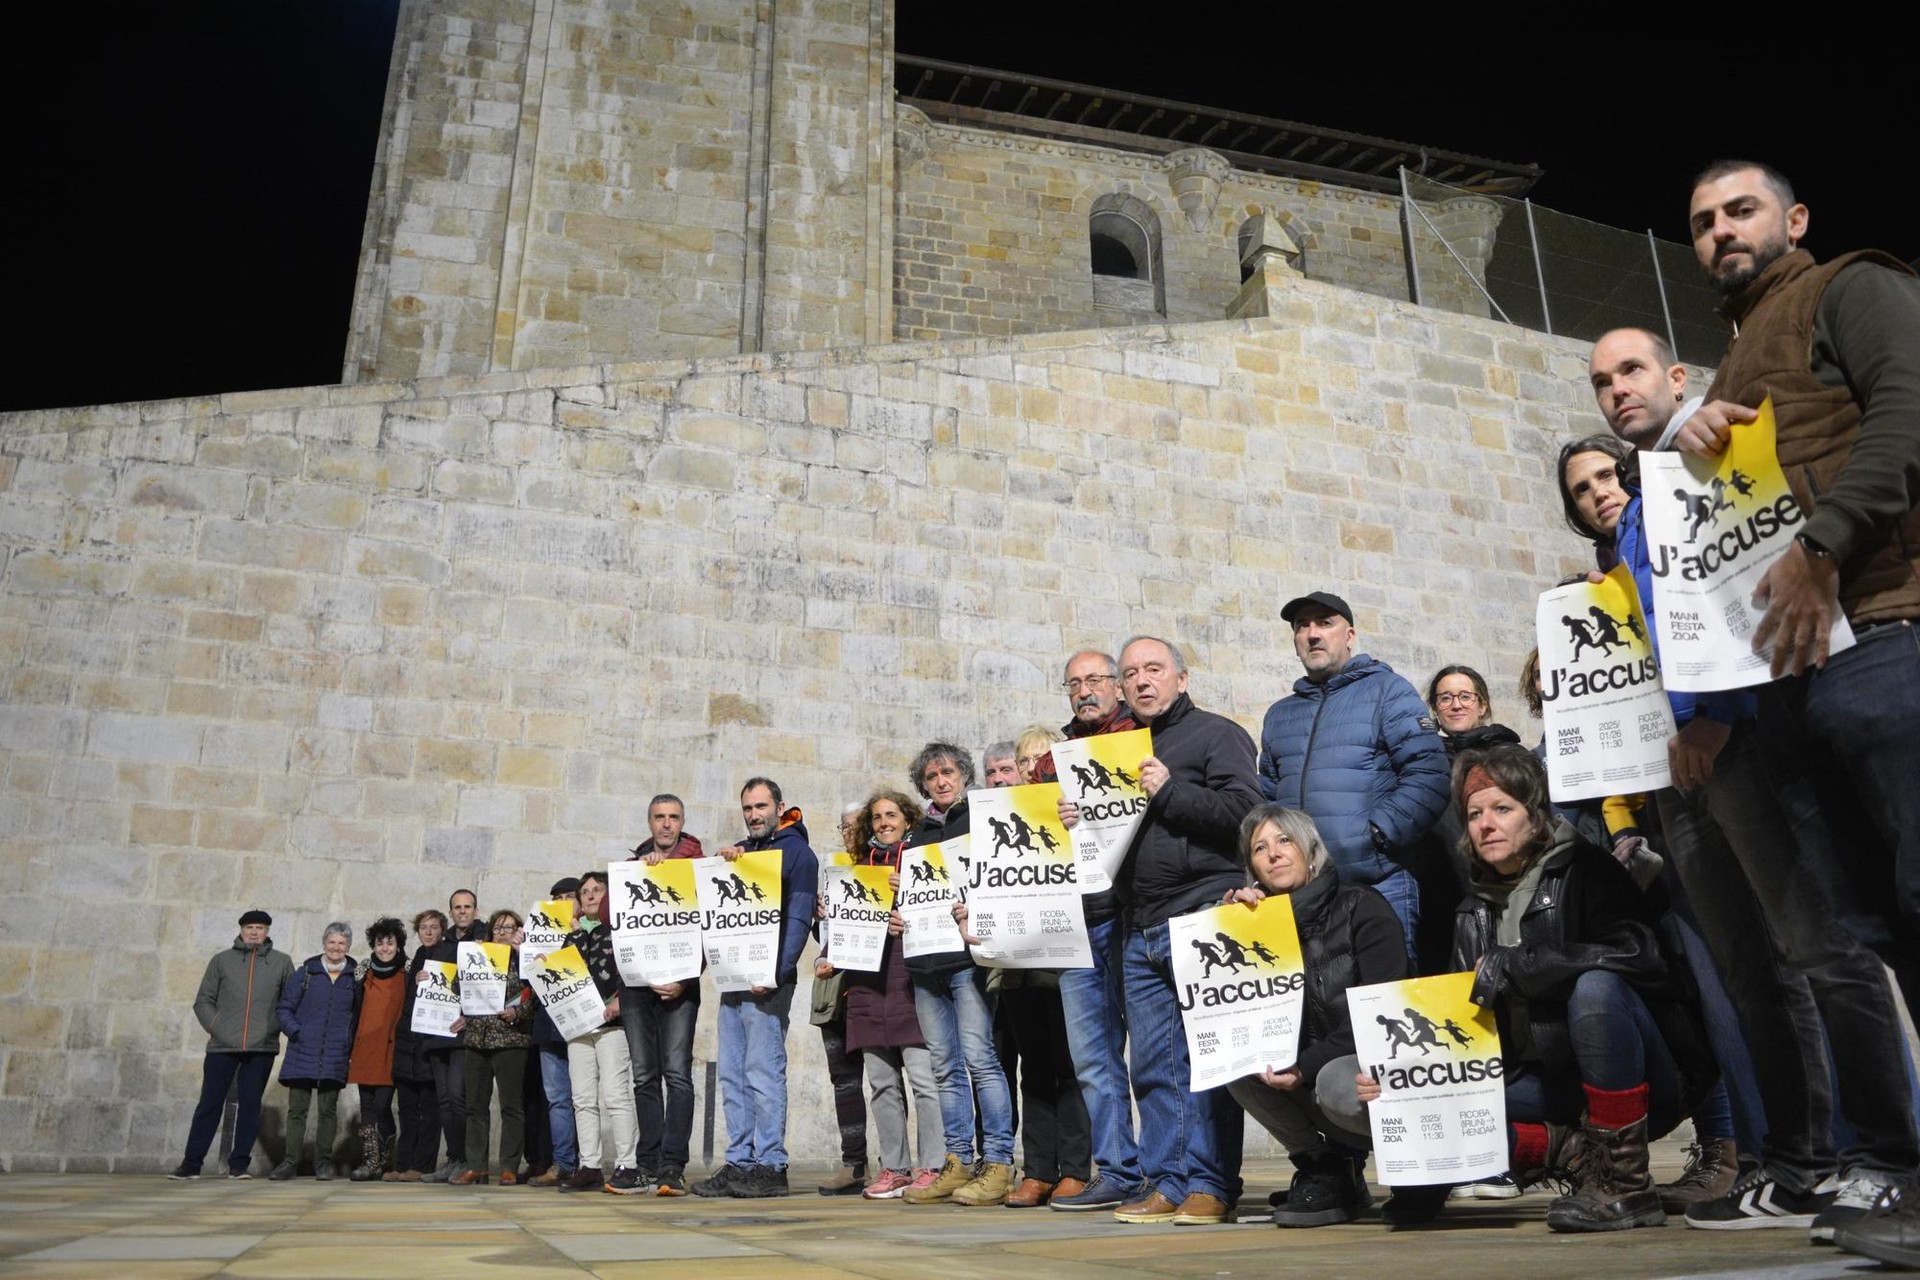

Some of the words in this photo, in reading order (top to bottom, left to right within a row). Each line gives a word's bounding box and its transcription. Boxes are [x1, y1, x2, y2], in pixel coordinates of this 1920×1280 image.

[1650, 493, 1803, 582] J'accuse
[1669, 611, 1699, 621] MANI
[1670, 621, 1705, 631] FESTA
[1672, 631, 1700, 641] ZIOA
[1541, 655, 1658, 701] J'accus
[1558, 726, 1580, 737] MANI
[1599, 730, 1622, 741] 01/26
[1559, 736, 1585, 746] FESTA
[1601, 739, 1623, 750] 11:30
[1559, 746, 1580, 756] ZIOA
[1080, 841, 1097, 849] MANI
[1081, 847, 1100, 855] FESTA
[969, 861, 1077, 889] J'accuse
[828, 904, 891, 922] J'accuse
[610, 910, 701, 931] J'accuse
[701, 909, 781, 931] J'accuse
[521, 931, 567, 943] J'accus
[542, 976, 594, 1008] J'accuse
[1180, 972, 1305, 1011] J'accuse
[1197, 1031, 1216, 1040] MANI
[1198, 1039, 1220, 1047] FESTA
[1420, 1114, 1442, 1123] 2025/
[1459, 1109, 1490, 1119] FICOBA
[1382, 1126, 1407, 1134] FESTA
[1421, 1123, 1443, 1132] 01/26
[1462, 1125, 1497, 1137] HENDAIA
[1423, 1131, 1444, 1141] 11:30
